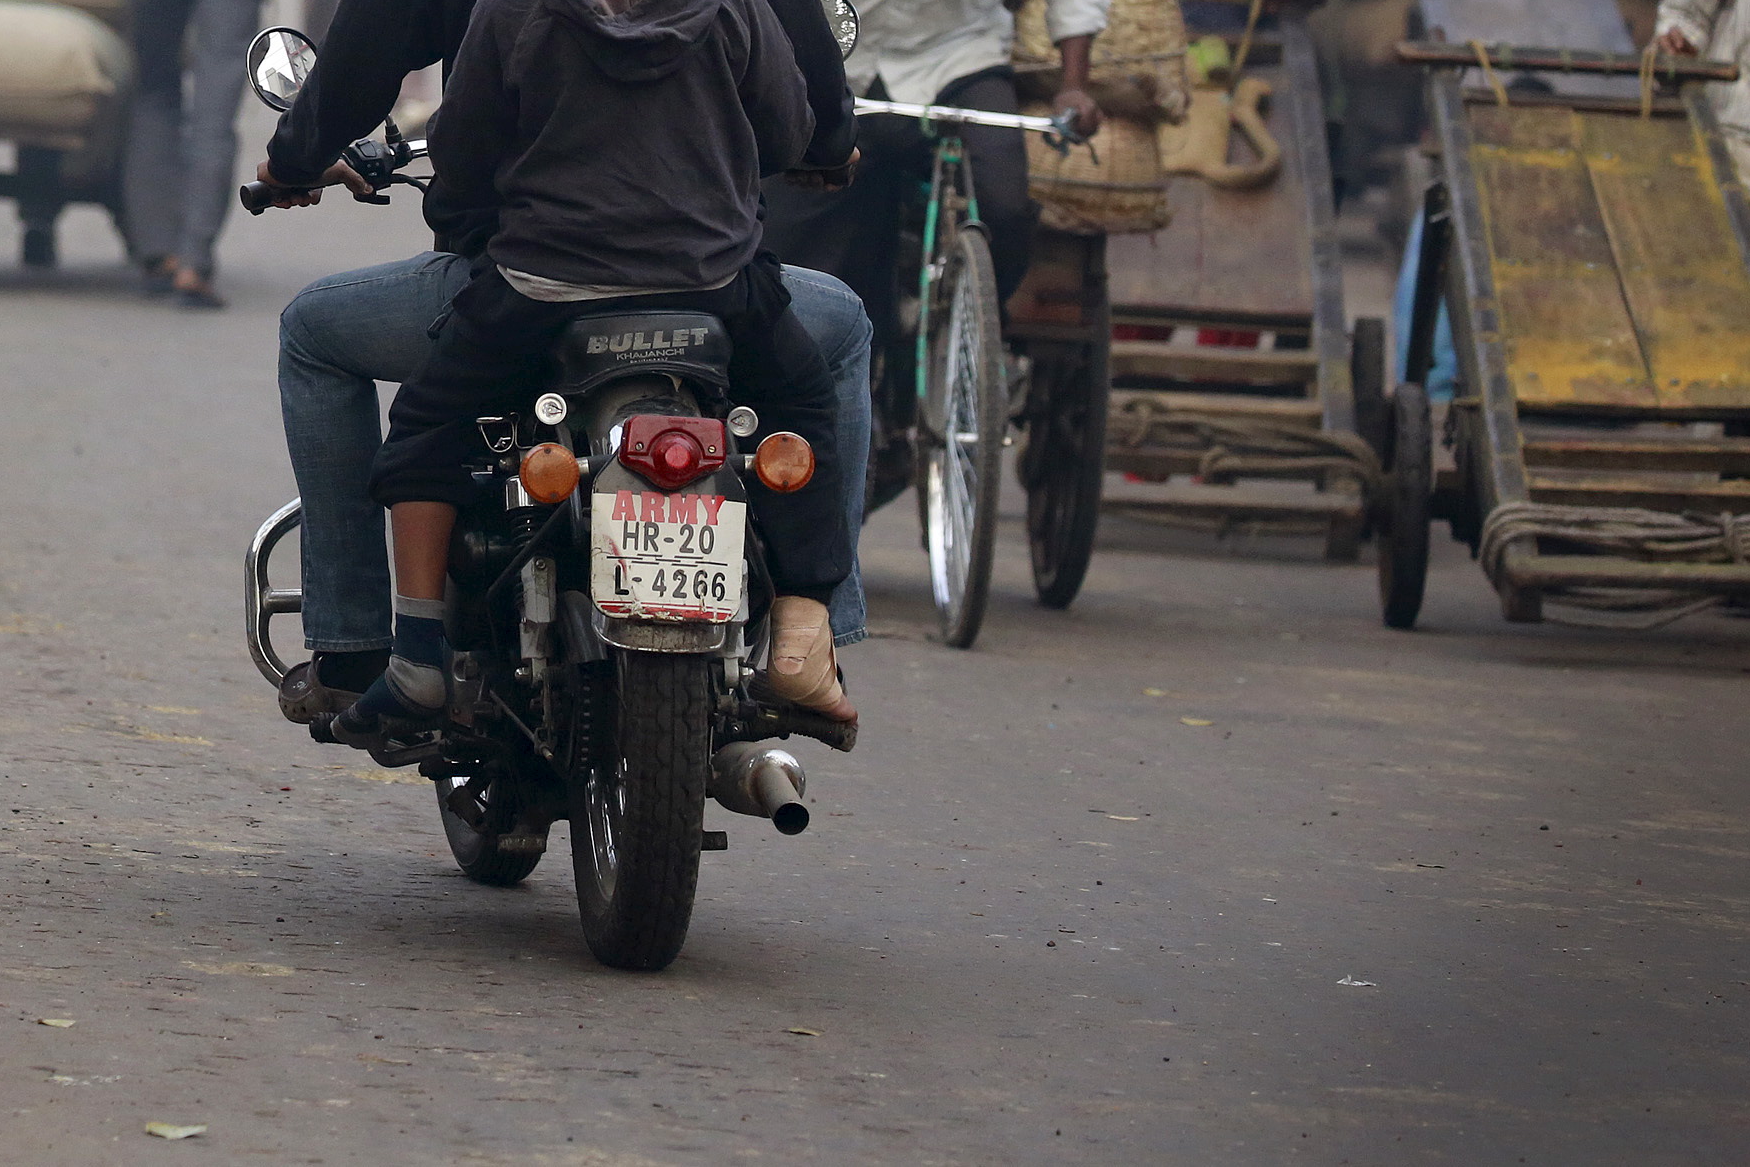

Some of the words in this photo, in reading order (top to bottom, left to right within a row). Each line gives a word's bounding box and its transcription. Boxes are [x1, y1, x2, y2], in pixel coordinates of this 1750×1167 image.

[587, 327, 709, 354] BULLET
[616, 348, 685, 361] KHAJANCHI
[612, 490, 725, 525] ARMY
[622, 520, 715, 554] HR-20
